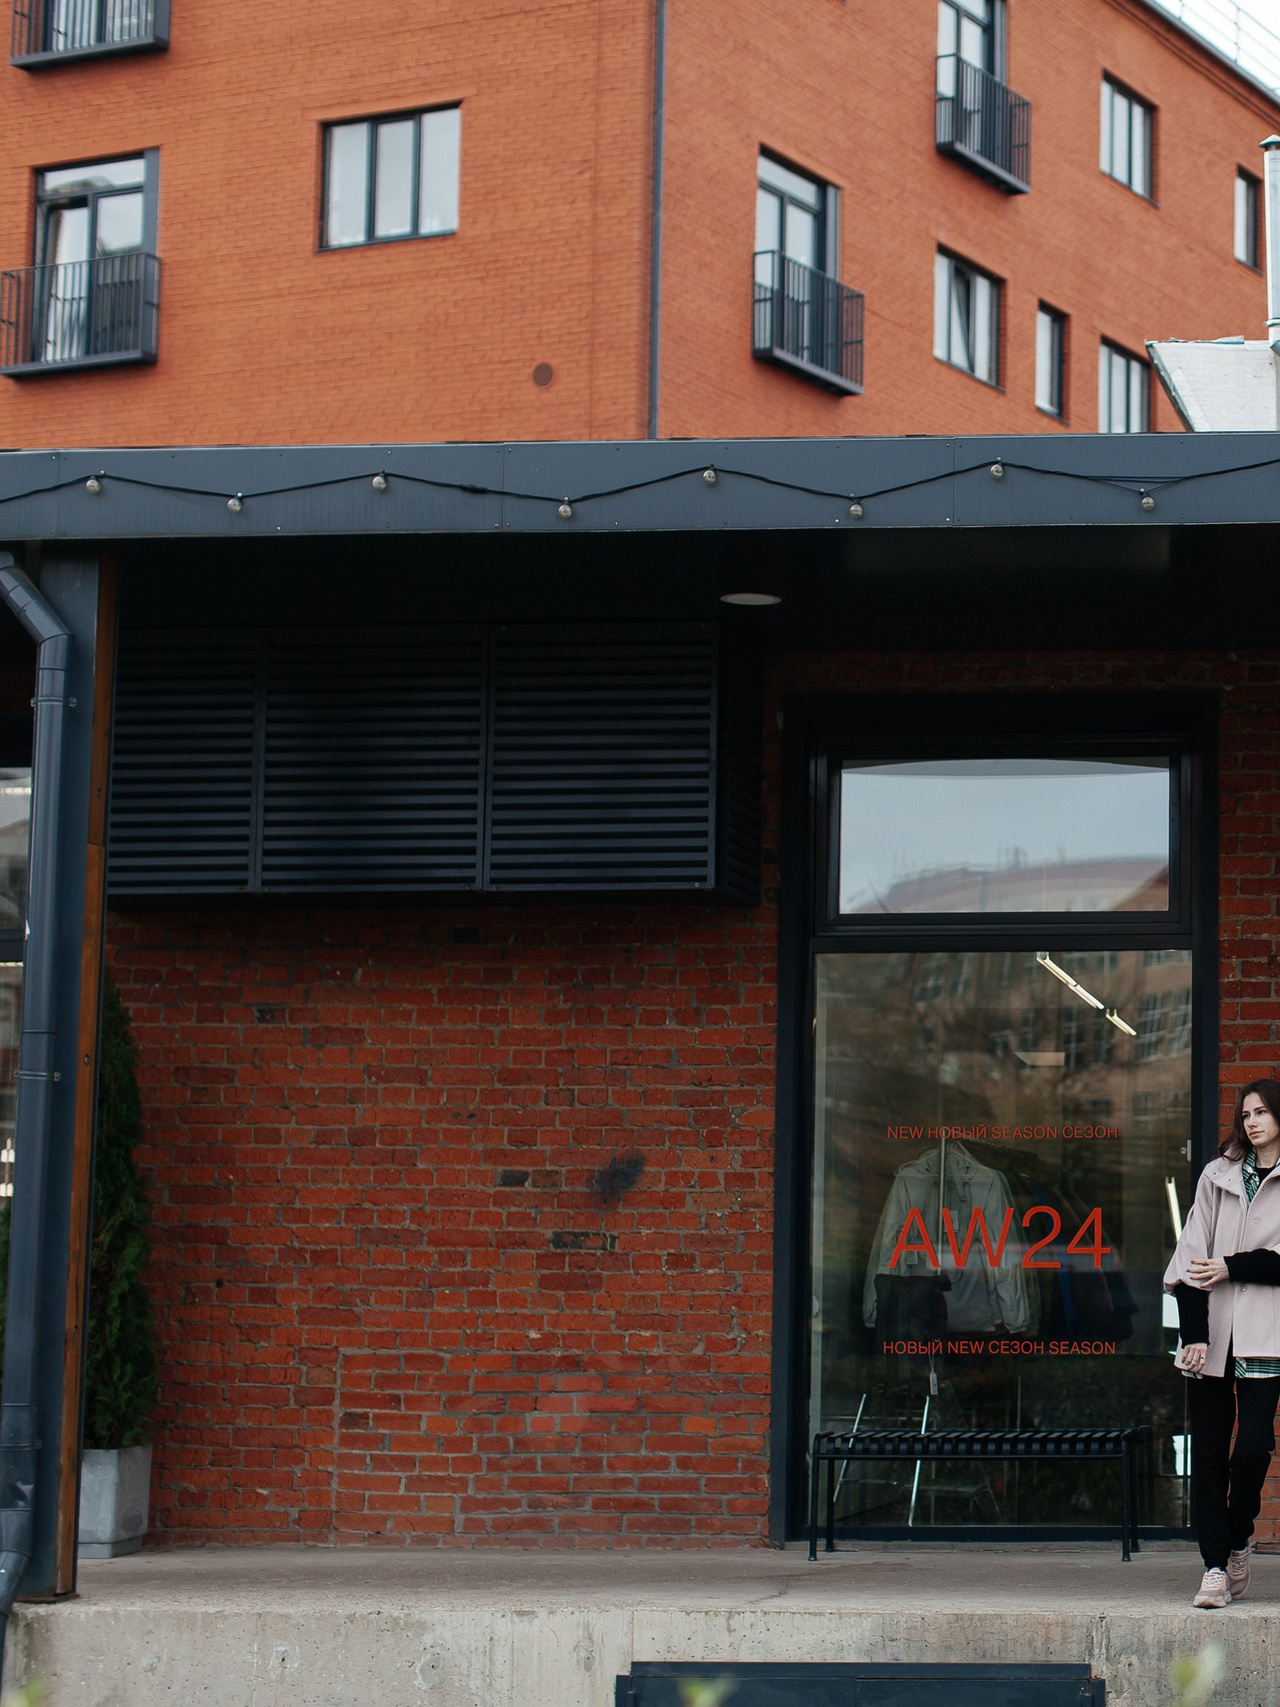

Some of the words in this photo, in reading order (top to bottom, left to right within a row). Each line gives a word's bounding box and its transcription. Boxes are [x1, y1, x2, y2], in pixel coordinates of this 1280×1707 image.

[887, 1125, 924, 1139] NEW
[928, 1123, 987, 1139] НОВЫЙ
[991, 1125, 1058, 1139] SEASON
[1062, 1125, 1118, 1139] СЕЗОН
[888, 1205, 1111, 1269] AW24
[883, 1339, 943, 1355] НОВЫЙ
[947, 1341, 985, 1354] NEW
[988, 1341, 1044, 1355] СЕЗОН
[1048, 1341, 1116, 1355] SEASON
